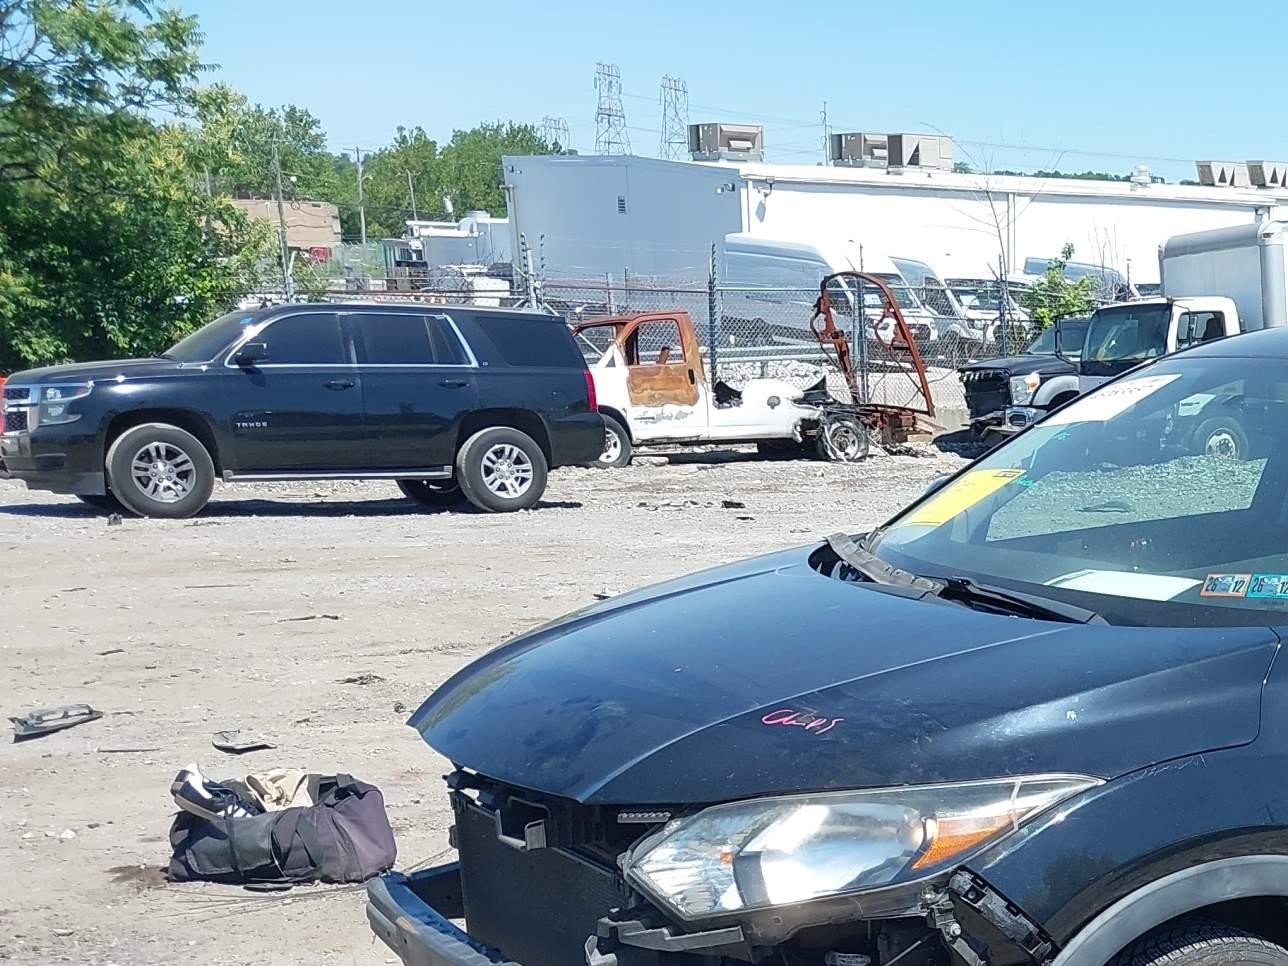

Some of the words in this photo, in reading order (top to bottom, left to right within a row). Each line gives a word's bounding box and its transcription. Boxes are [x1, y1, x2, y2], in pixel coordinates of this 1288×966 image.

[234, 421, 268, 429] TAHOE
[1205, 576, 1218, 592] 26
[1231, 580, 1245, 593] 12
[1251, 576, 1265, 593] 26
